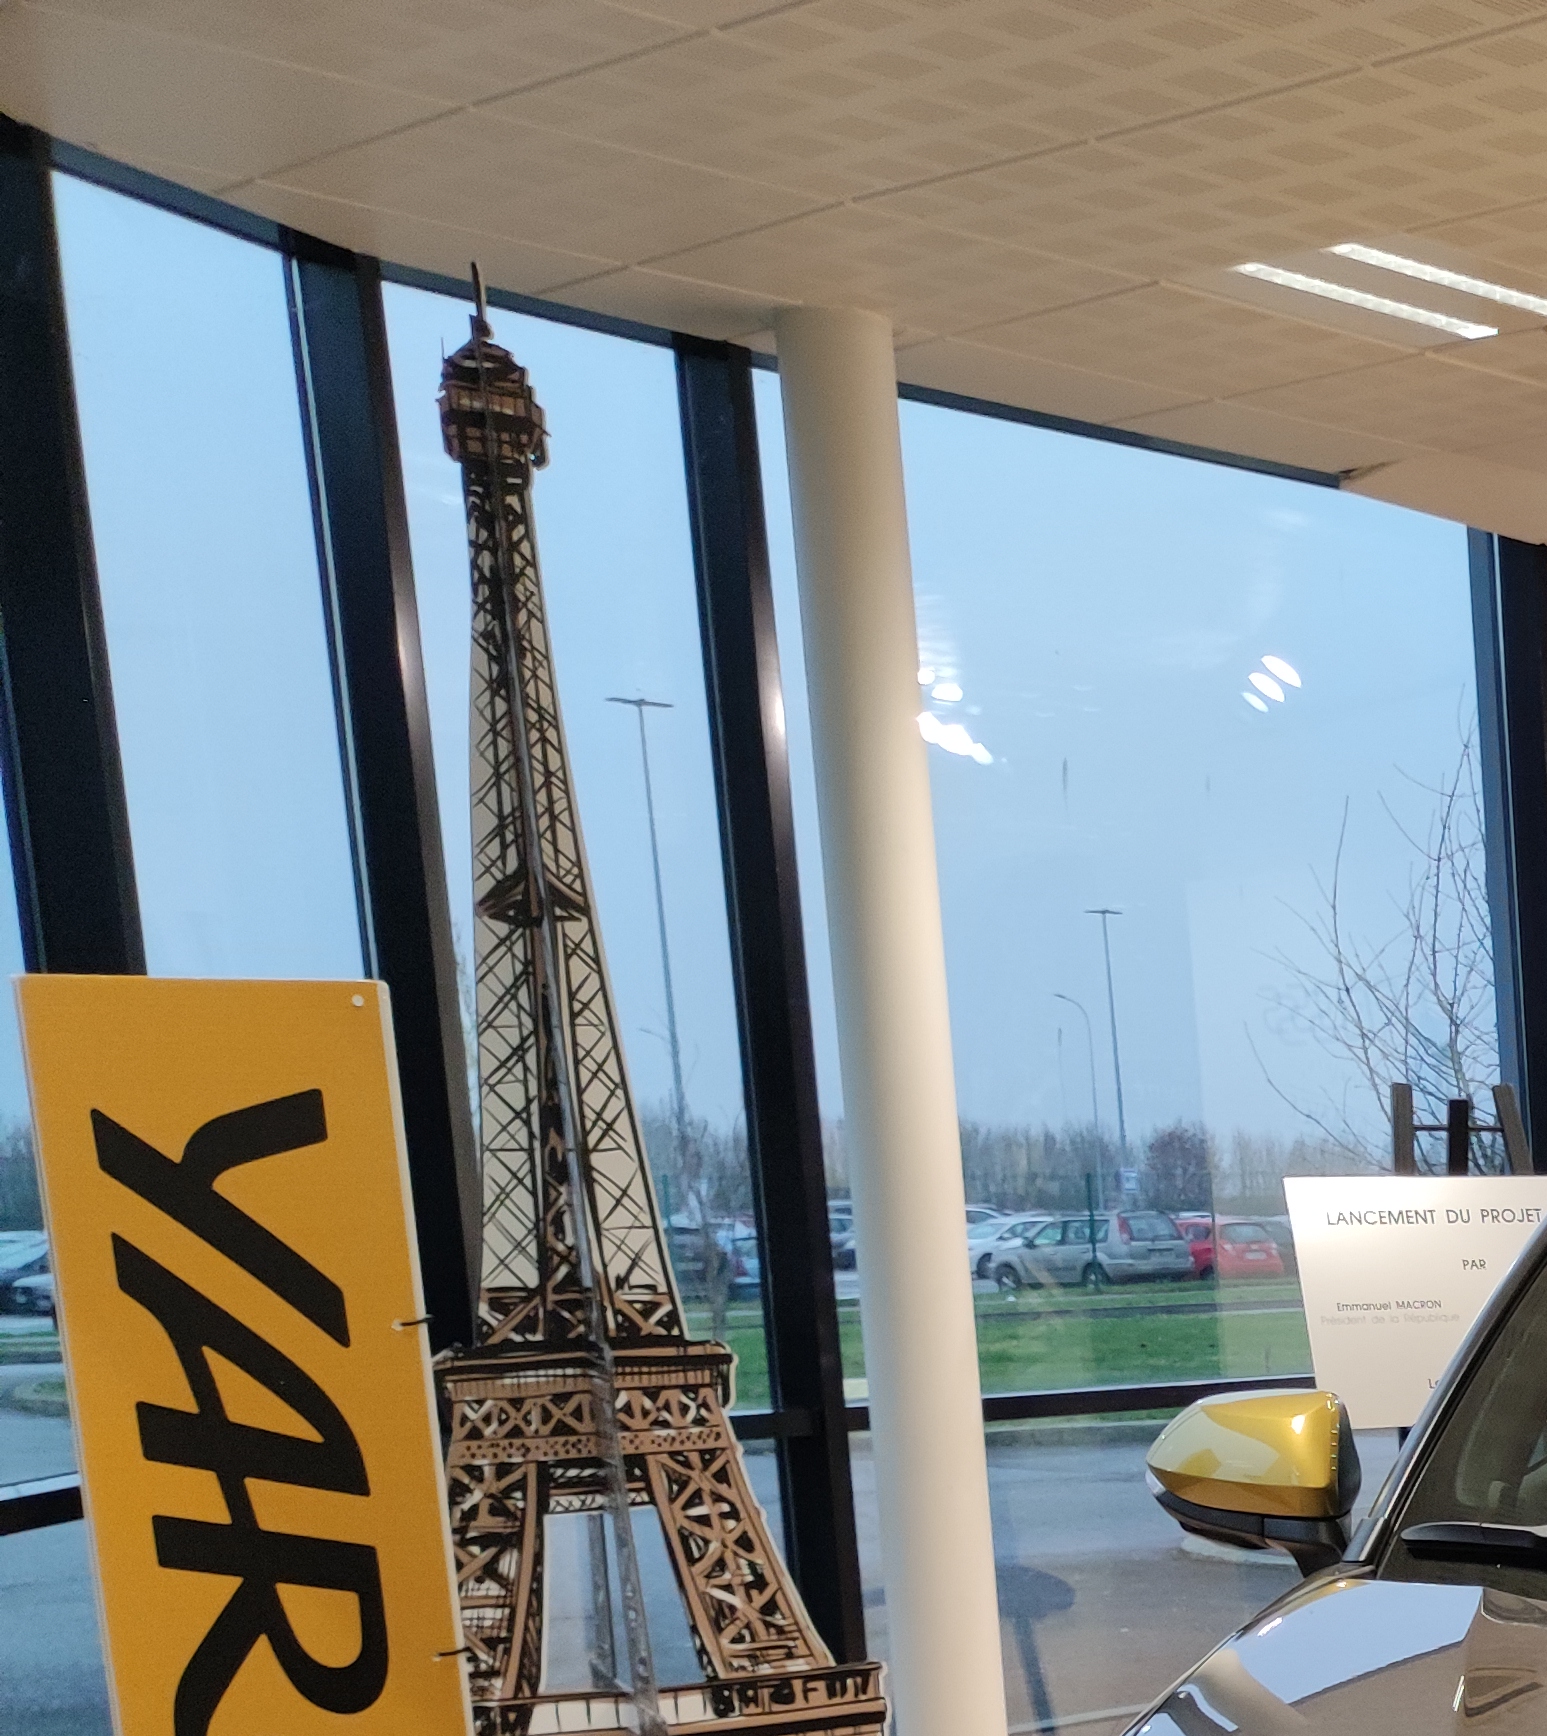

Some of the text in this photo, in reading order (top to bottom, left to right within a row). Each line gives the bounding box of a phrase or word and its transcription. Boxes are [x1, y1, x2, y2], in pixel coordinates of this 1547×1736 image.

[1326, 1208, 1542, 1226] LANCEMENT DU PROJET
[1461, 1258, 1486, 1271] PAR
[1336, 1300, 1442, 1312] Emmanuel MACRON
